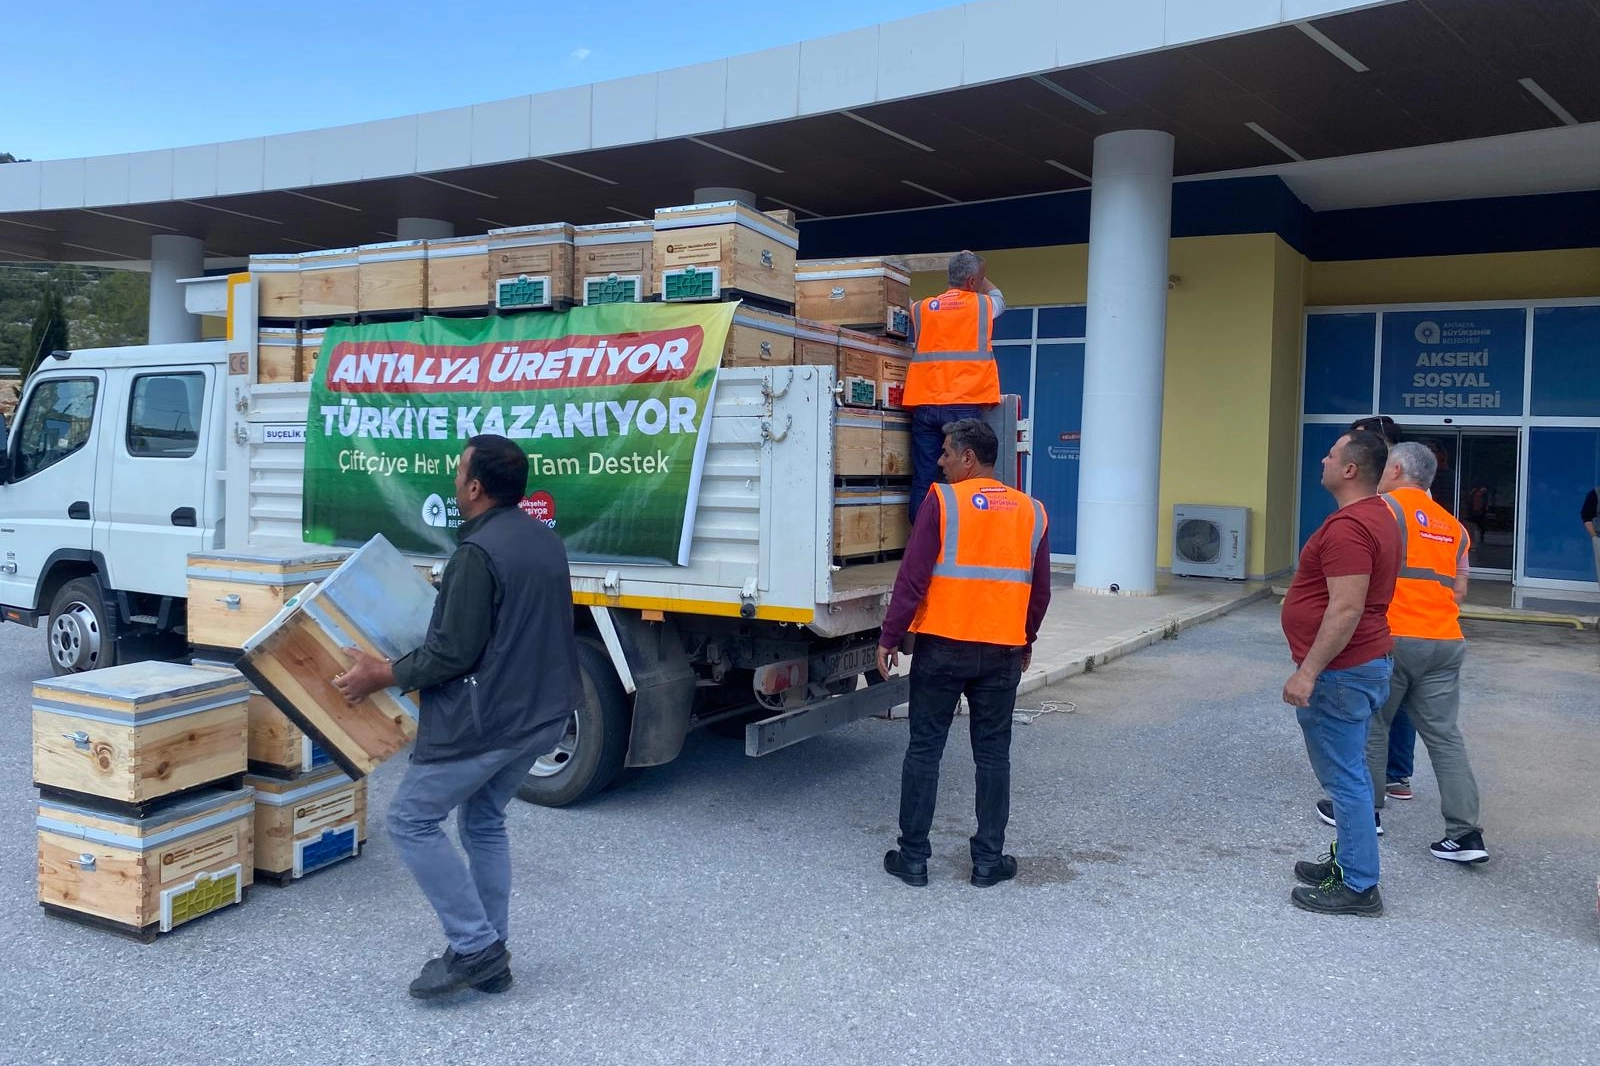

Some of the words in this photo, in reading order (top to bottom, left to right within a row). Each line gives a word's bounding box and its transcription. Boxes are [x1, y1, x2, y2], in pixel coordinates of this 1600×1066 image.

[332, 353, 480, 385] ANTALYA
[488, 337, 689, 382] ÜRETİYOR
[1416, 348, 1489, 367] AKSEKİ
[1413, 372, 1491, 387] SOSYAL
[1402, 390, 1500, 408] TESİSLERİ
[320, 398, 449, 440] TÜRKİYE
[456, 397, 698, 440] KAZANIYOR
[266, 429, 301, 439] SUÇELİK
[338, 449, 408, 476] Çiftçiye
[414, 452, 440, 475] Her
[529, 453, 580, 476] Tam
[588, 449, 669, 475] Destek
[519, 500, 548, 508] yükşehir
